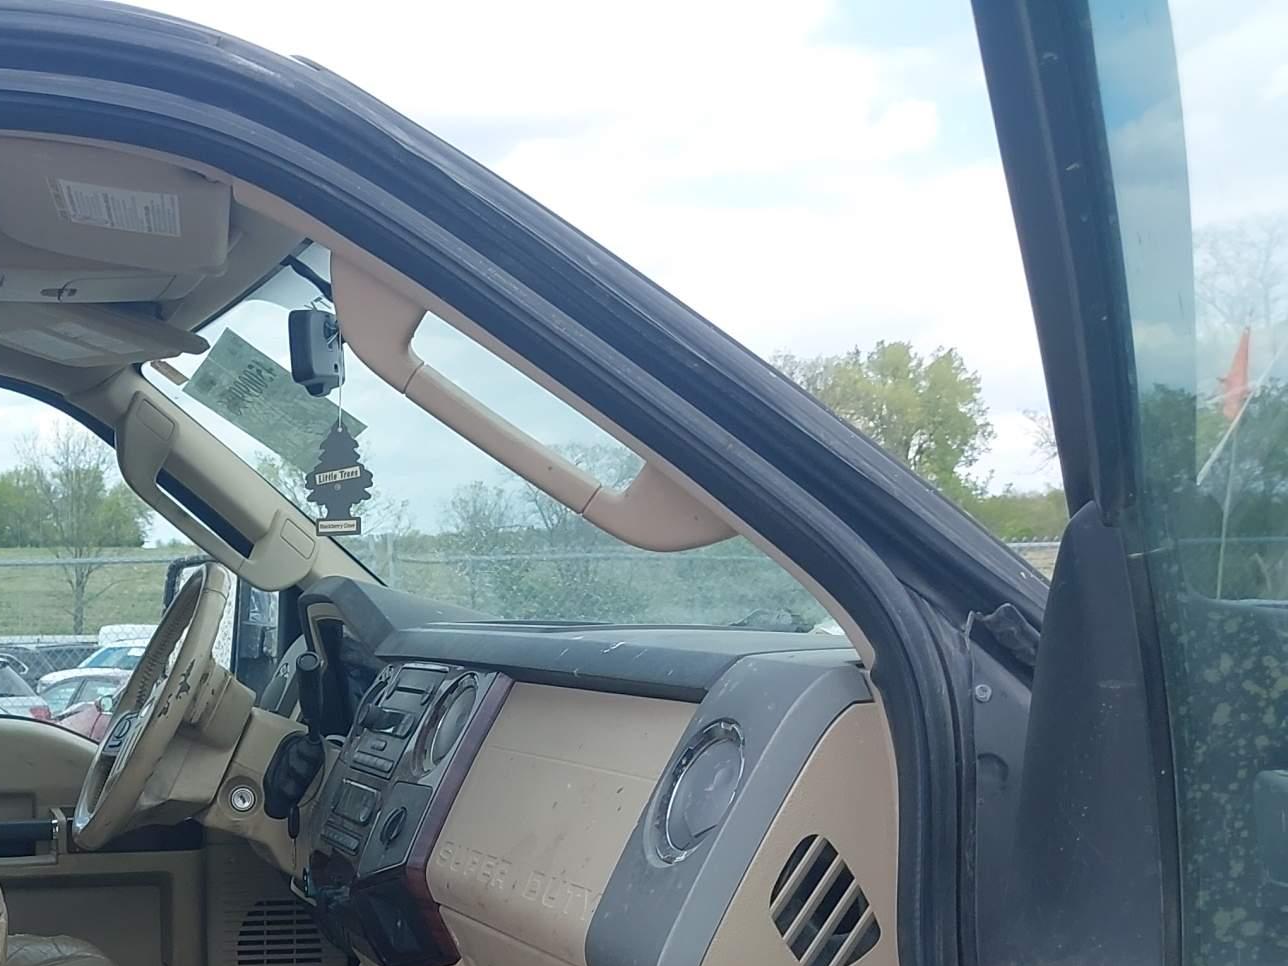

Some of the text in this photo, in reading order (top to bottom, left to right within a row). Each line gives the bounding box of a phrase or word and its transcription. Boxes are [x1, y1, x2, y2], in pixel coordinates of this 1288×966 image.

[318, 469, 359, 484] Little Trees
[436, 841, 512, 889] SUPER
